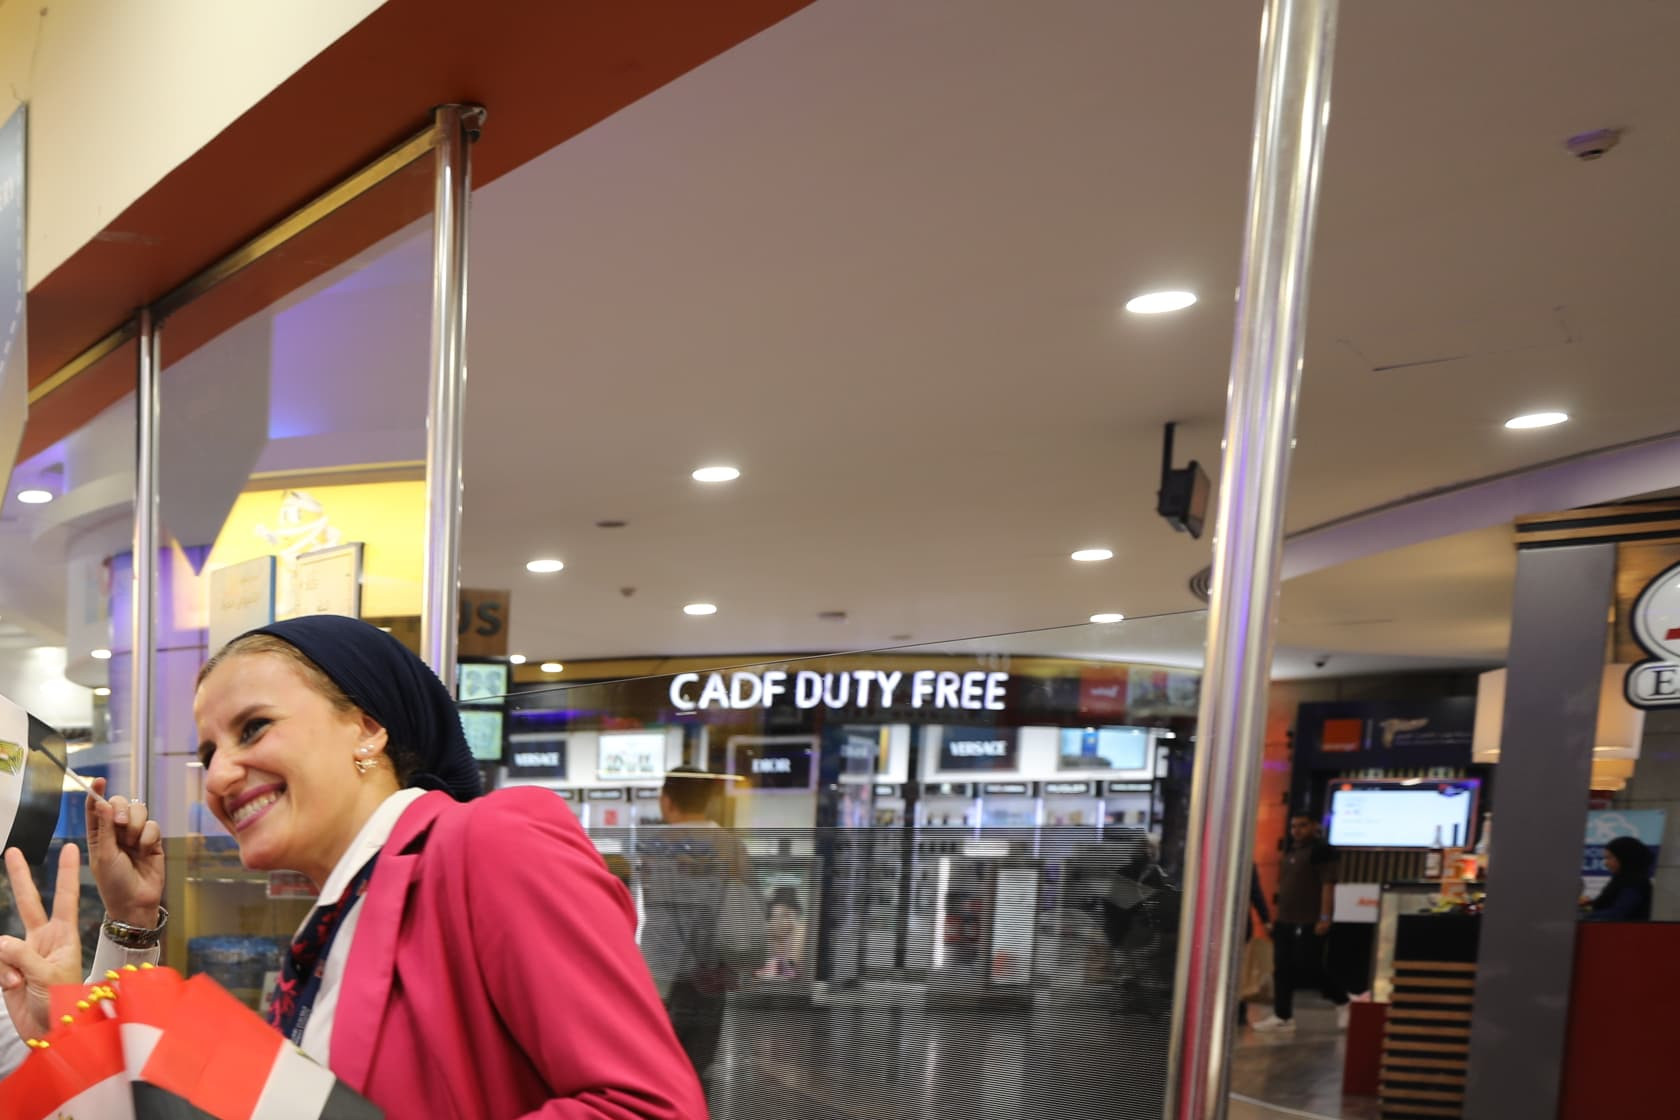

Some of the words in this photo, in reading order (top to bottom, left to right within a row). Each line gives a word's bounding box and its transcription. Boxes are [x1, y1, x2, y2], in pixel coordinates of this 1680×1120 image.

[669, 672, 787, 711] CADF
[795, 670, 902, 709] DUTY
[912, 669, 1009, 711] FREE
[949, 740, 1007, 757] VERSACE
[514, 751, 560, 767] VERSACE
[751, 757, 792, 773] DIOR
